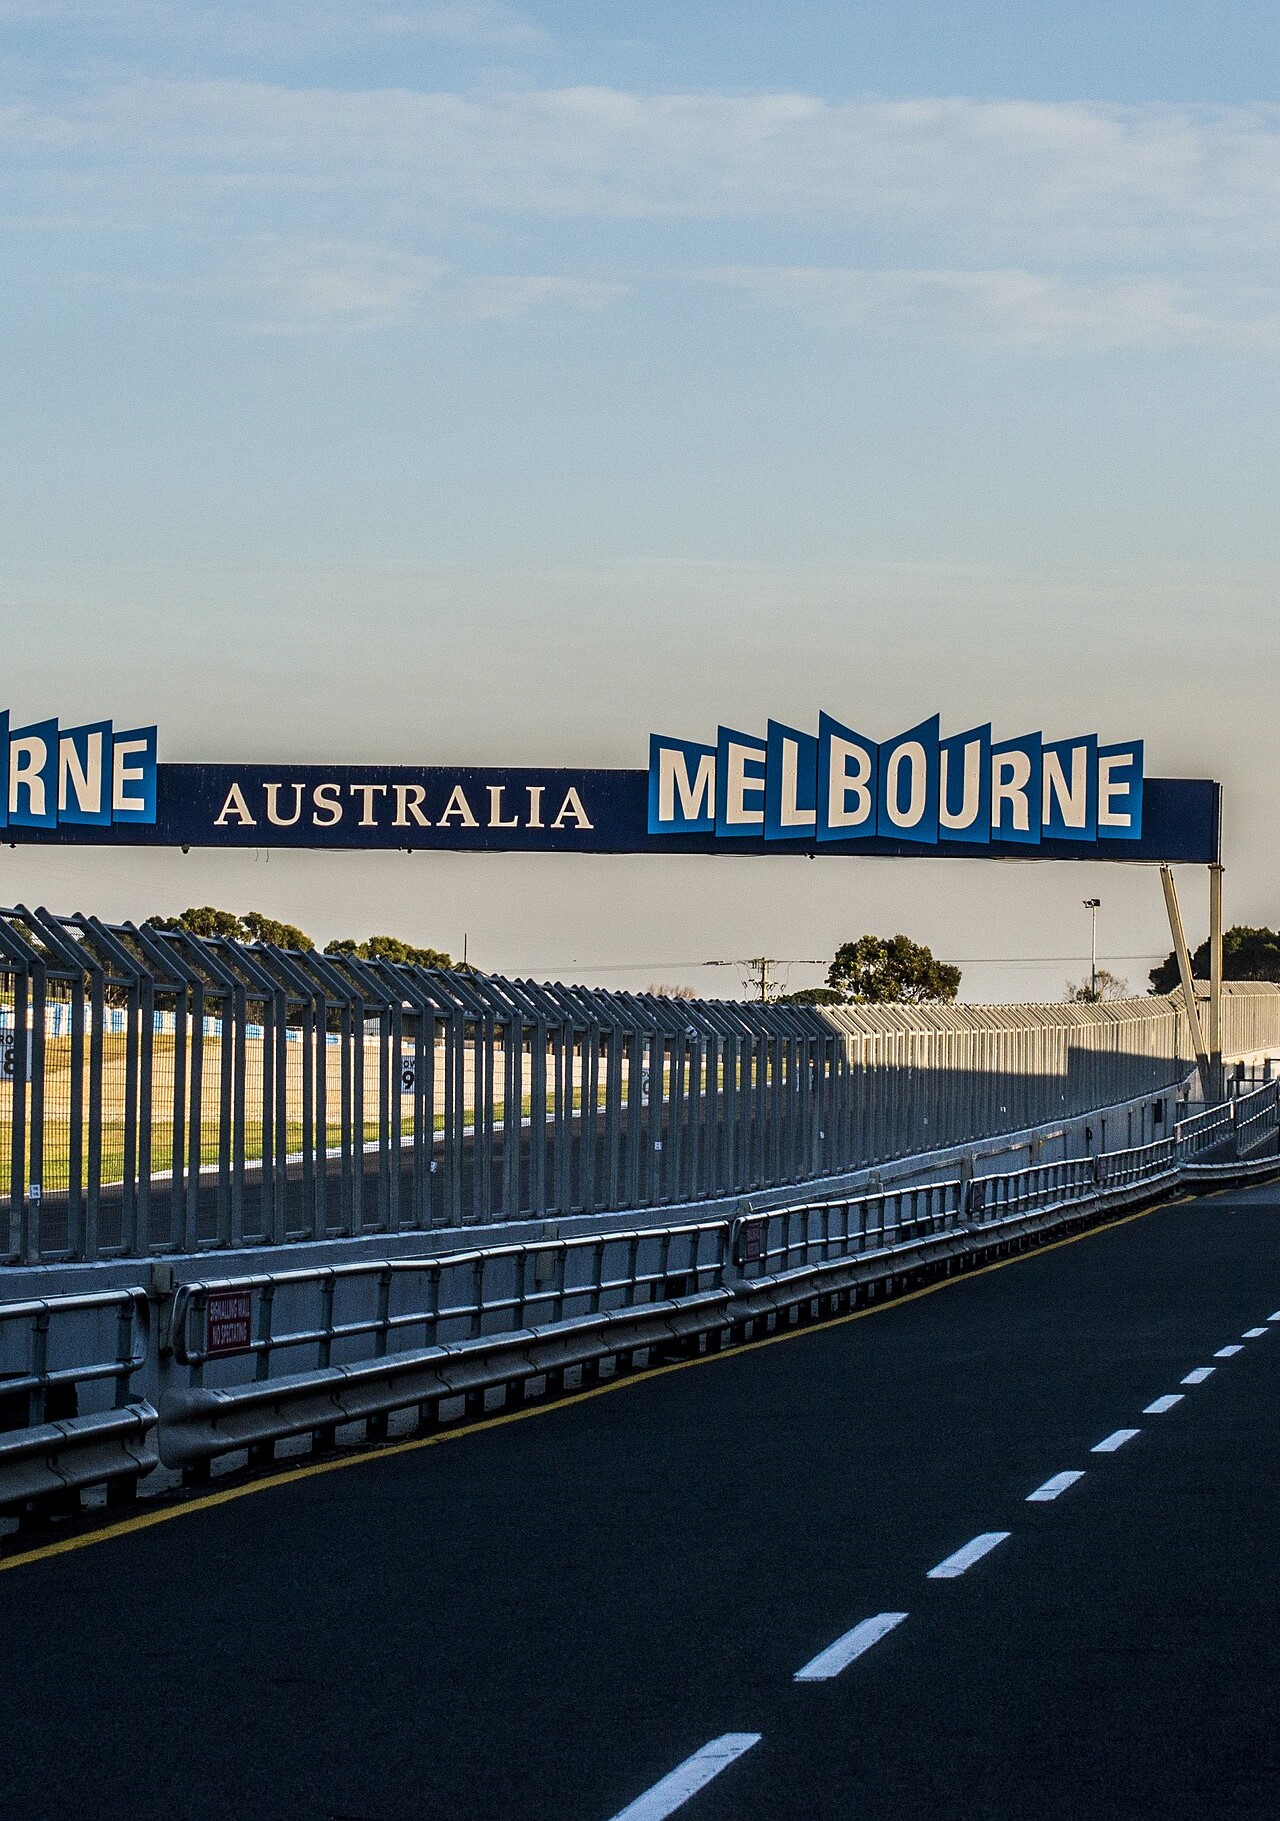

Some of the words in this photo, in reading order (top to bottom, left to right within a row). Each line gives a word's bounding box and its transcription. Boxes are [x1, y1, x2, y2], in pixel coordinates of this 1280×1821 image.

[214, 782, 594, 831] AUSTRALIA
[658, 735, 1132, 831] MELBOURNE
[402, 1070, 415, 1090] 9
